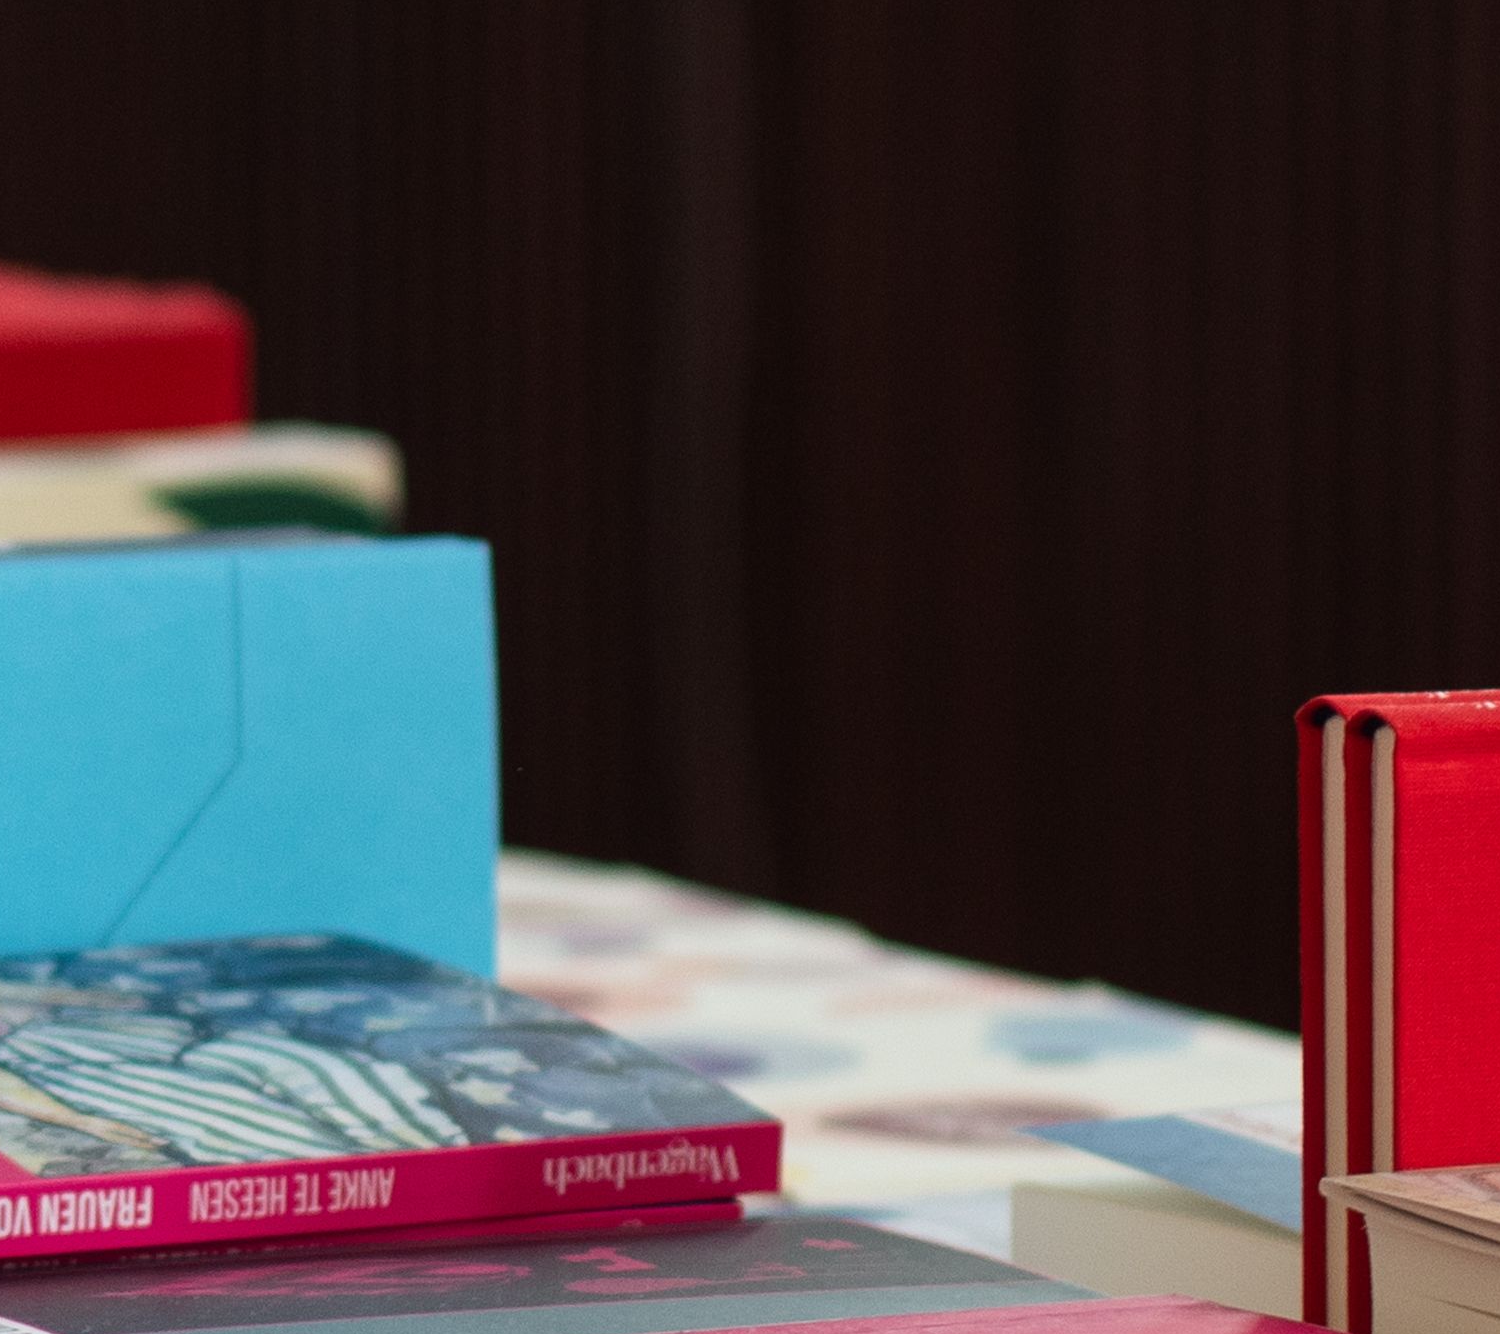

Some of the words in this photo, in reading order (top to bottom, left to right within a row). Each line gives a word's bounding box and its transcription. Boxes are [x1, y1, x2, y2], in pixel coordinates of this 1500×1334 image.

[328, 1167, 397, 1210] ANKE
[541, 1136, 742, 1195] Wagenbach
[39, 1186, 154, 1235] FRAUEN
[190, 1177, 287, 1223] HEESEN
[292, 1172, 324, 1213] TE
